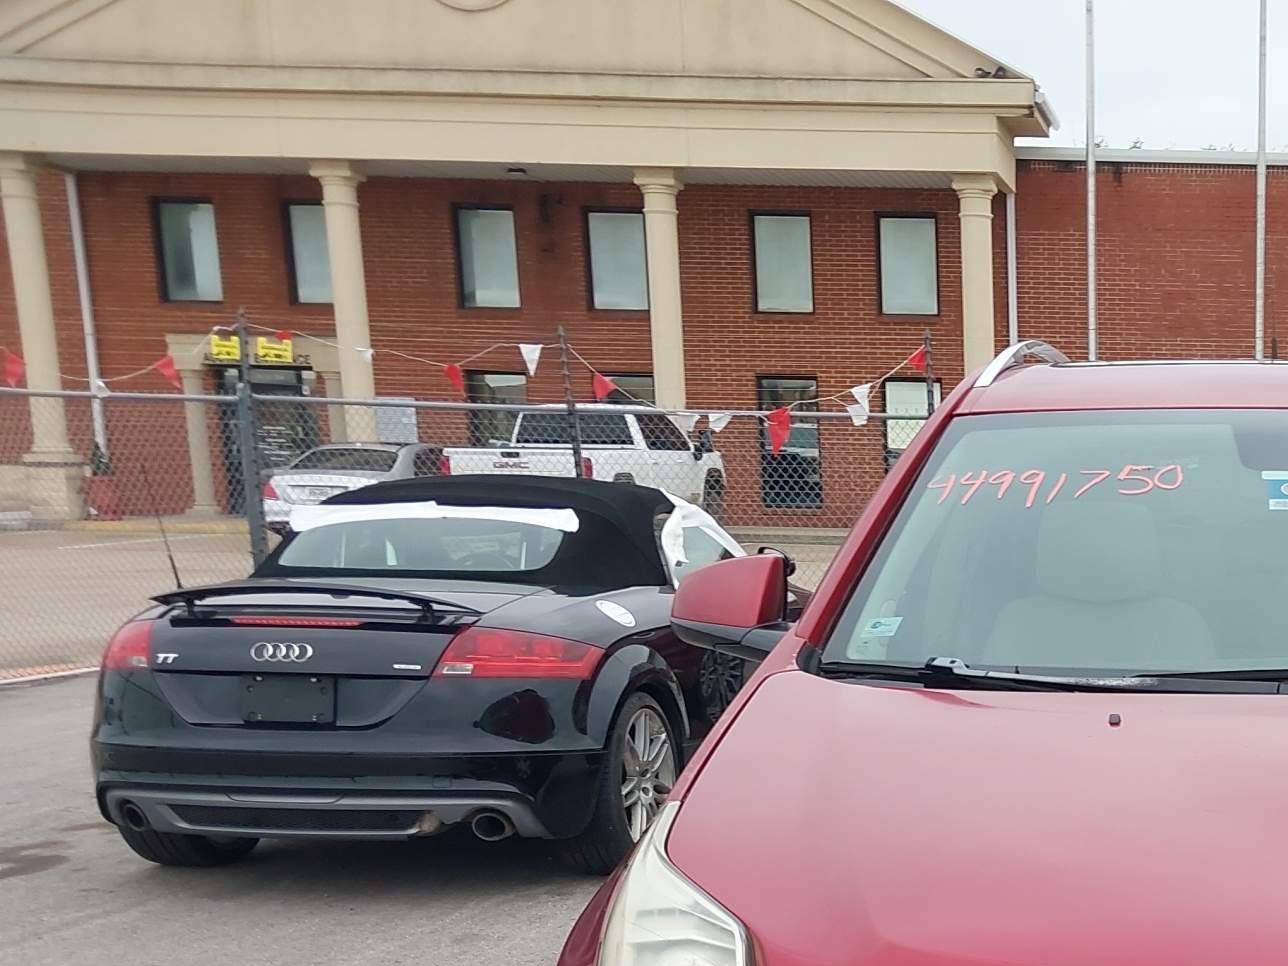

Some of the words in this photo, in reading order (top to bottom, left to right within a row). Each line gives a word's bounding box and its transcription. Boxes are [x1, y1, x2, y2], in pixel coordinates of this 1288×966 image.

[493, 461, 530, 469] GMC
[927, 463, 1184, 508] 44991750
[156, 653, 180, 664] TT
